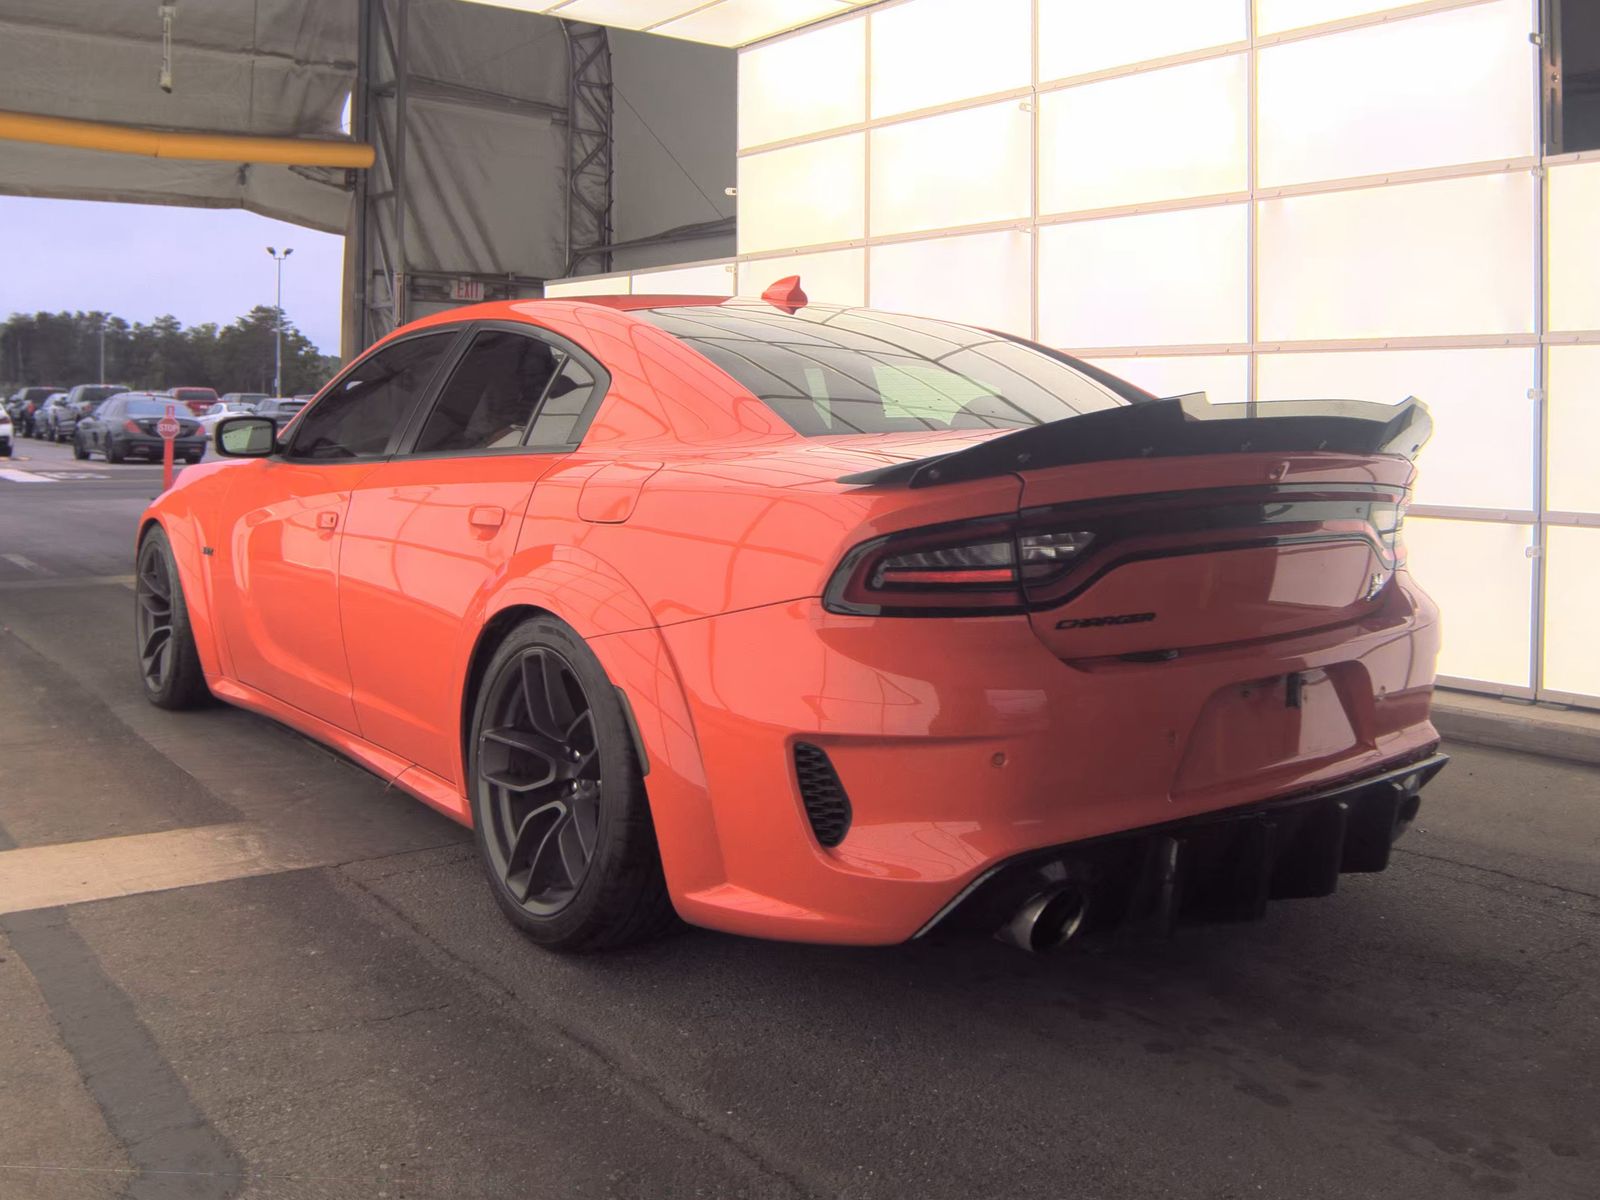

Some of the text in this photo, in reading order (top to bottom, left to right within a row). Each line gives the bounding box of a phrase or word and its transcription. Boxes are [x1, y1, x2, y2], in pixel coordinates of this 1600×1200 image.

[456, 280, 480, 298] EXIT
[159, 423, 177, 432] STOP
[1055, 612, 1156, 630] CHARGER
